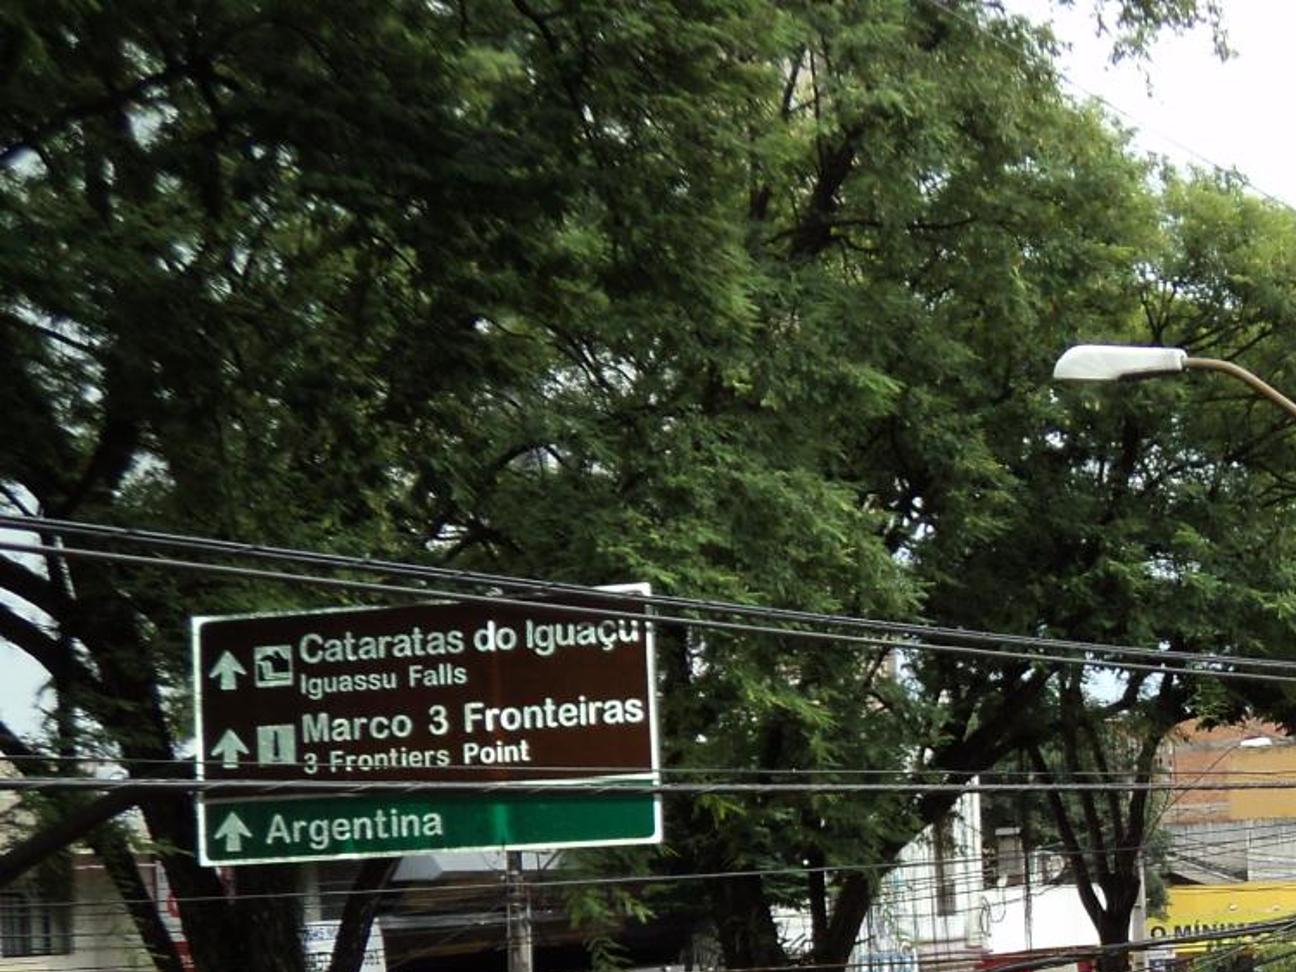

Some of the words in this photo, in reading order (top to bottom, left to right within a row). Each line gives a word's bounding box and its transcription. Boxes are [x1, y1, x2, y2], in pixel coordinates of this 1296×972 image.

[300, 627, 464, 664] Cataratas
[474, 620, 517, 652] do
[300, 672, 397, 700] Iguassu
[409, 664, 468, 687] Falls
[302, 713, 412, 743] Marco
[428, 705, 449, 736] 3
[464, 696, 644, 733] Fronteiras
[303, 753, 318, 774] 3
[329, 747, 450, 773] Frontiers
[463, 739, 531, 764] Point
[264, 809, 443, 850] Argentina
